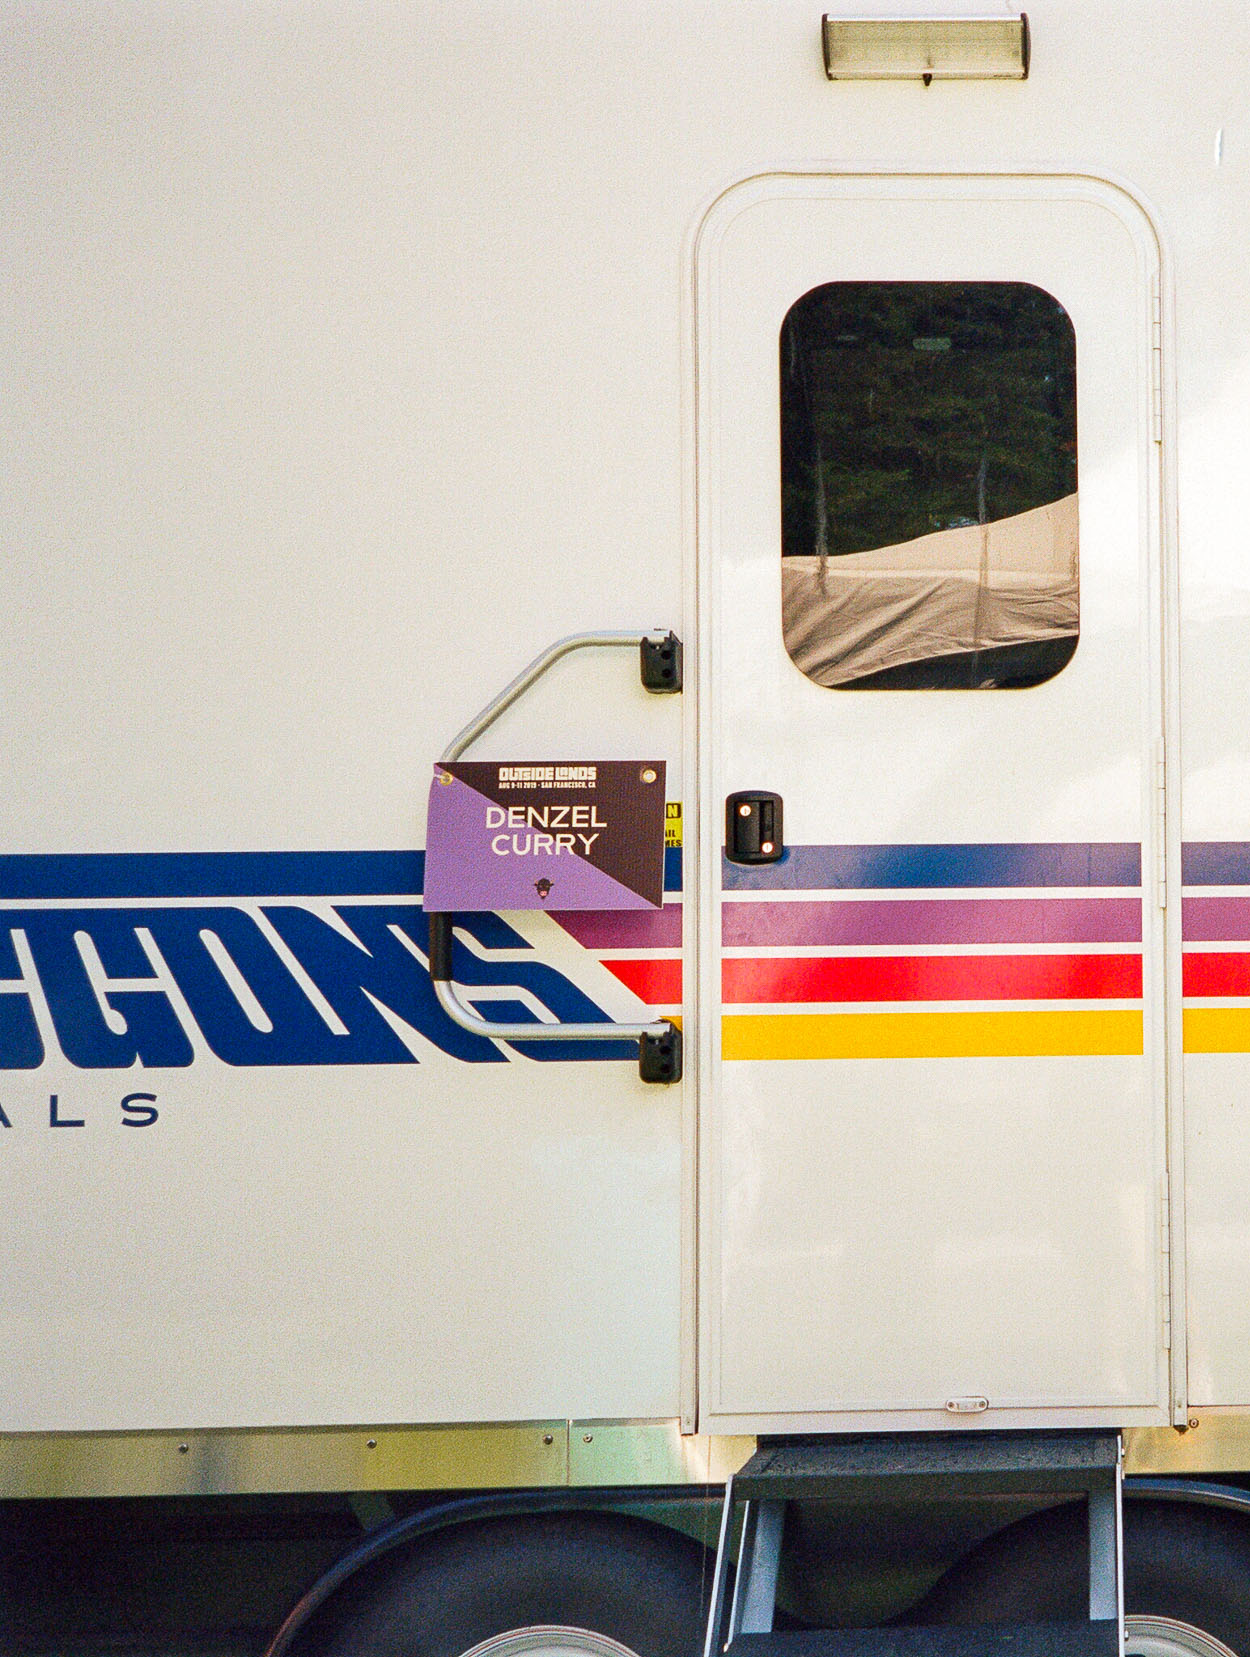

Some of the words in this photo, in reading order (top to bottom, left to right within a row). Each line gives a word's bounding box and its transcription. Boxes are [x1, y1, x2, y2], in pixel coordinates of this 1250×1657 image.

[498, 767, 554, 781] OUTSIDE
[541, 781, 553, 789] SAN
[485, 805, 608, 829] DENZEL
[491, 832, 600, 857] CURRY
